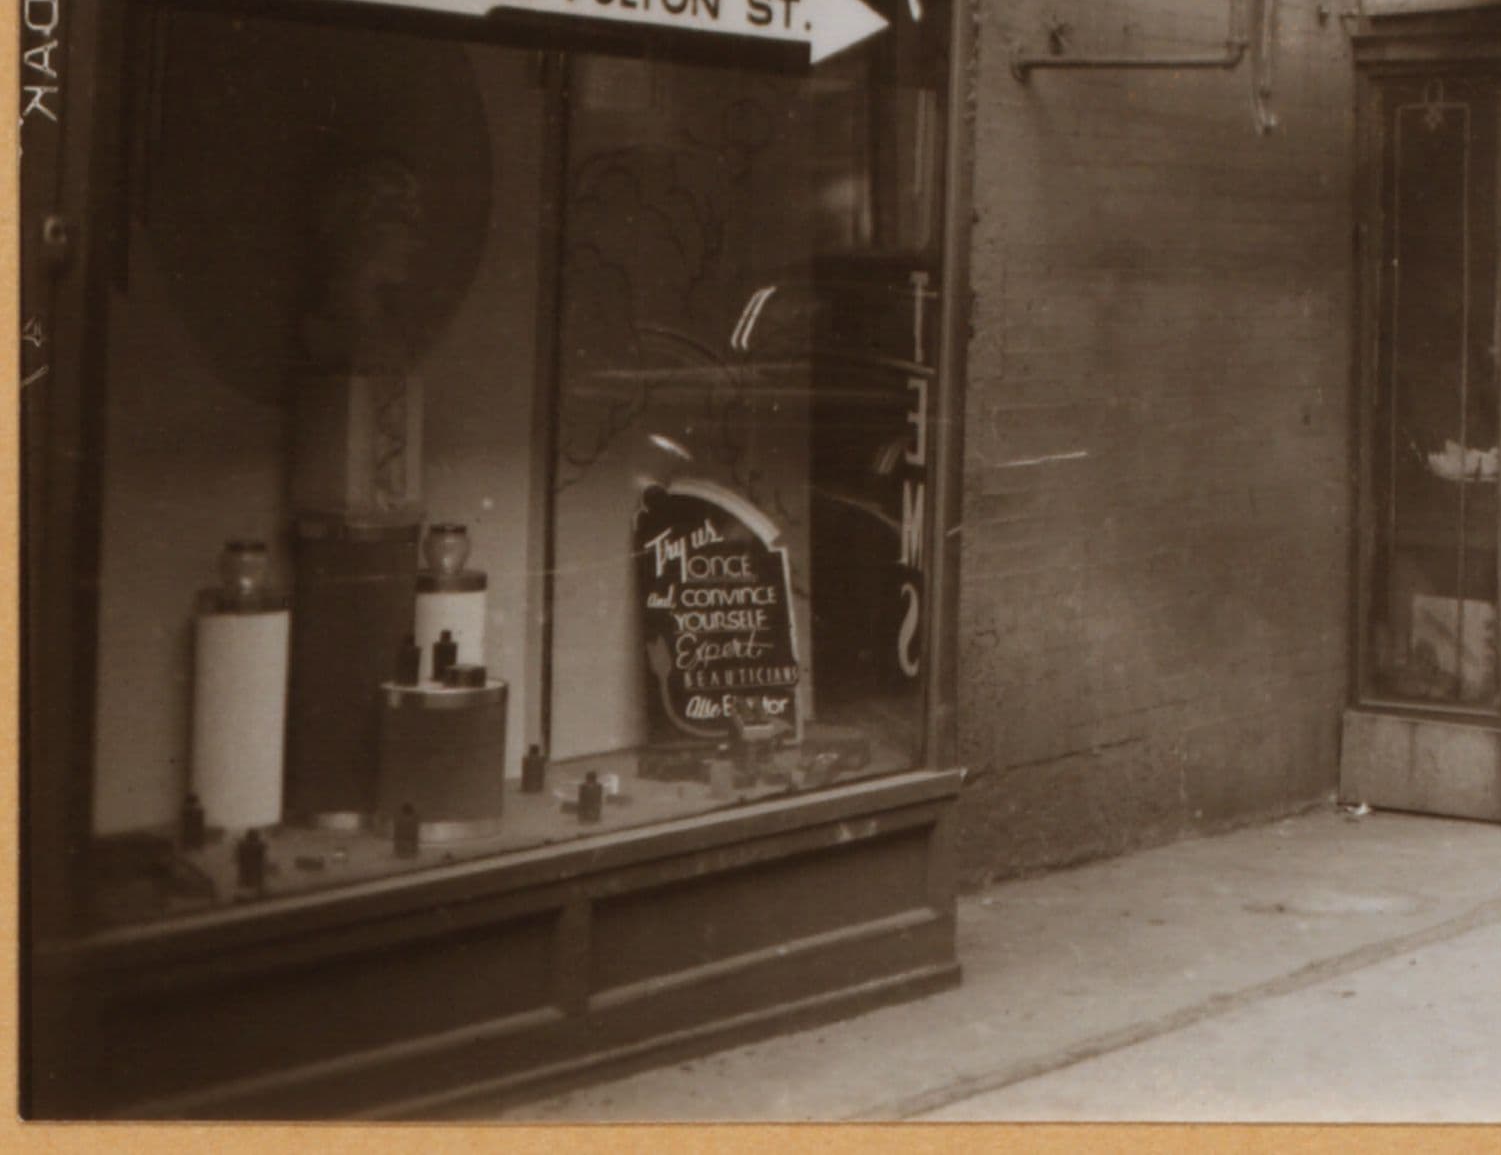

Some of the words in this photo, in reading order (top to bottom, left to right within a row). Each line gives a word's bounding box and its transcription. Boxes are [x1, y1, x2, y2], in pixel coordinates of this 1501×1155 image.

[644, 526, 688, 584] Try
[690, 518, 724, 549] us
[674, 609, 768, 632] YOURSELF
